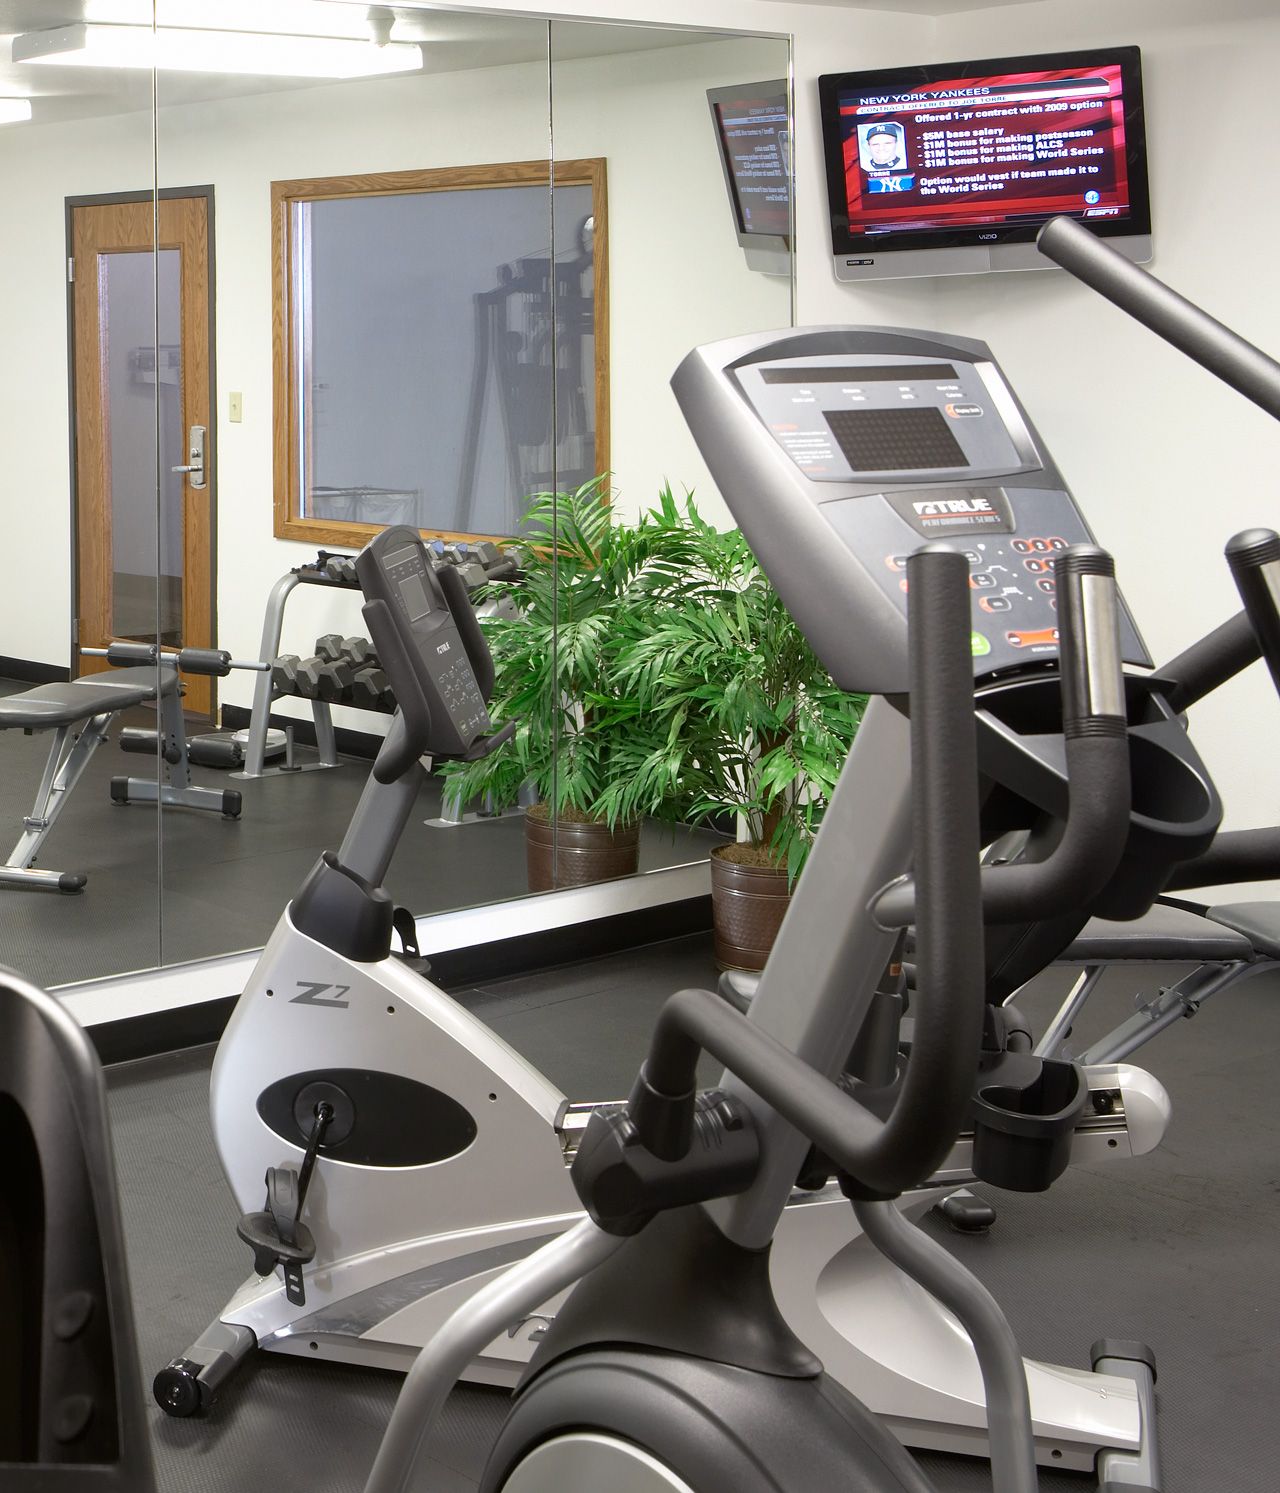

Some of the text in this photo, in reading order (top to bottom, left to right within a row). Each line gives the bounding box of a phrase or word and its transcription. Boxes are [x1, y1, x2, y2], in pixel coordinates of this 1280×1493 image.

[860, 87, 990, 105] NEW YORK YANKEES
[914, 100, 1103, 123] Offered 1-yr contract with 2009 option
[922, 127, 1004, 140] $5M base salary
[923, 129, 1094, 149] $1M bonus for making postseason
[924, 140, 1063, 158] $1M bonus for making ALCS
[924, 147, 1104, 168] $1M bonus for making World Series
[920, 177, 953, 187] Option
[954, 174, 986, 184] would
[987, 172, 1010, 181] vest
[1020, 169, 1046, 178] team
[1048, 167, 1076, 176] made
[1087, 165, 1099, 173] to
[920, 182, 1004, 195] the World Series
[1086, 208, 1119, 217] ESPN
[936, 498, 992, 513] TRUE
